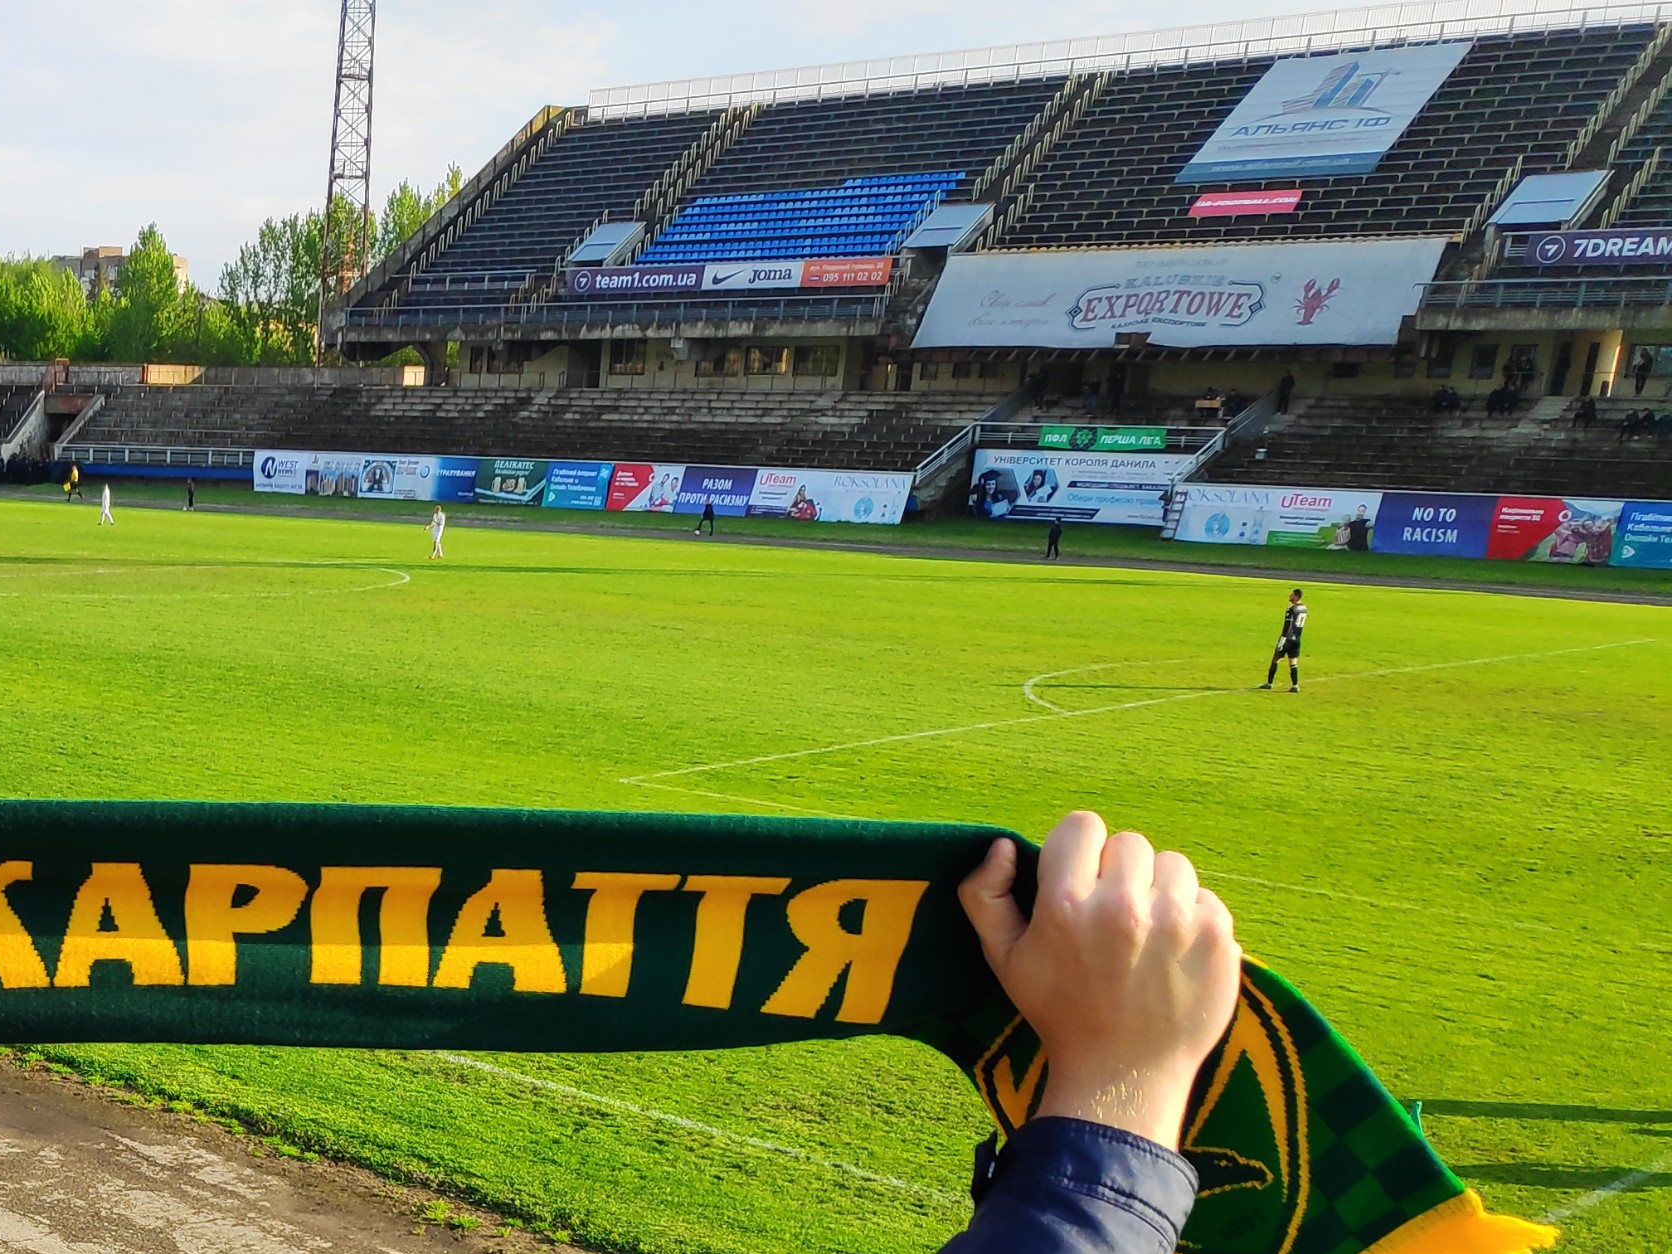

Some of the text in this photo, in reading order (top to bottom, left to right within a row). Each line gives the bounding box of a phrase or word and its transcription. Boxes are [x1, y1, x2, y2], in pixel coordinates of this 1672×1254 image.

[1230, 119, 1349, 138] АЛЬЯНС
[595, 271, 697, 289] team1.com.ua
[1081, 289, 1254, 323] EXPORTOWE
[1044, 434, 1068, 443] ПФЛ
[1100, 435, 1136, 445] ПЕРША
[278, 460, 299, 469] WEST
[993, 456, 1156, 469] УНІВЕРСИТЕТ КОРОЛЯ ДАНИЛА
[702, 478, 732, 490] РАЗОМ
[834, 475, 906, 490] ROKSOLANA
[678, 492, 707, 504] ПРОТИ
[709, 494, 749, 506] РАСИЗМУ
[1281, 493, 1332, 509] UTeam
[1412, 506, 1457, 523] NO TO
[1402, 526, 1458, 544] RACISM
